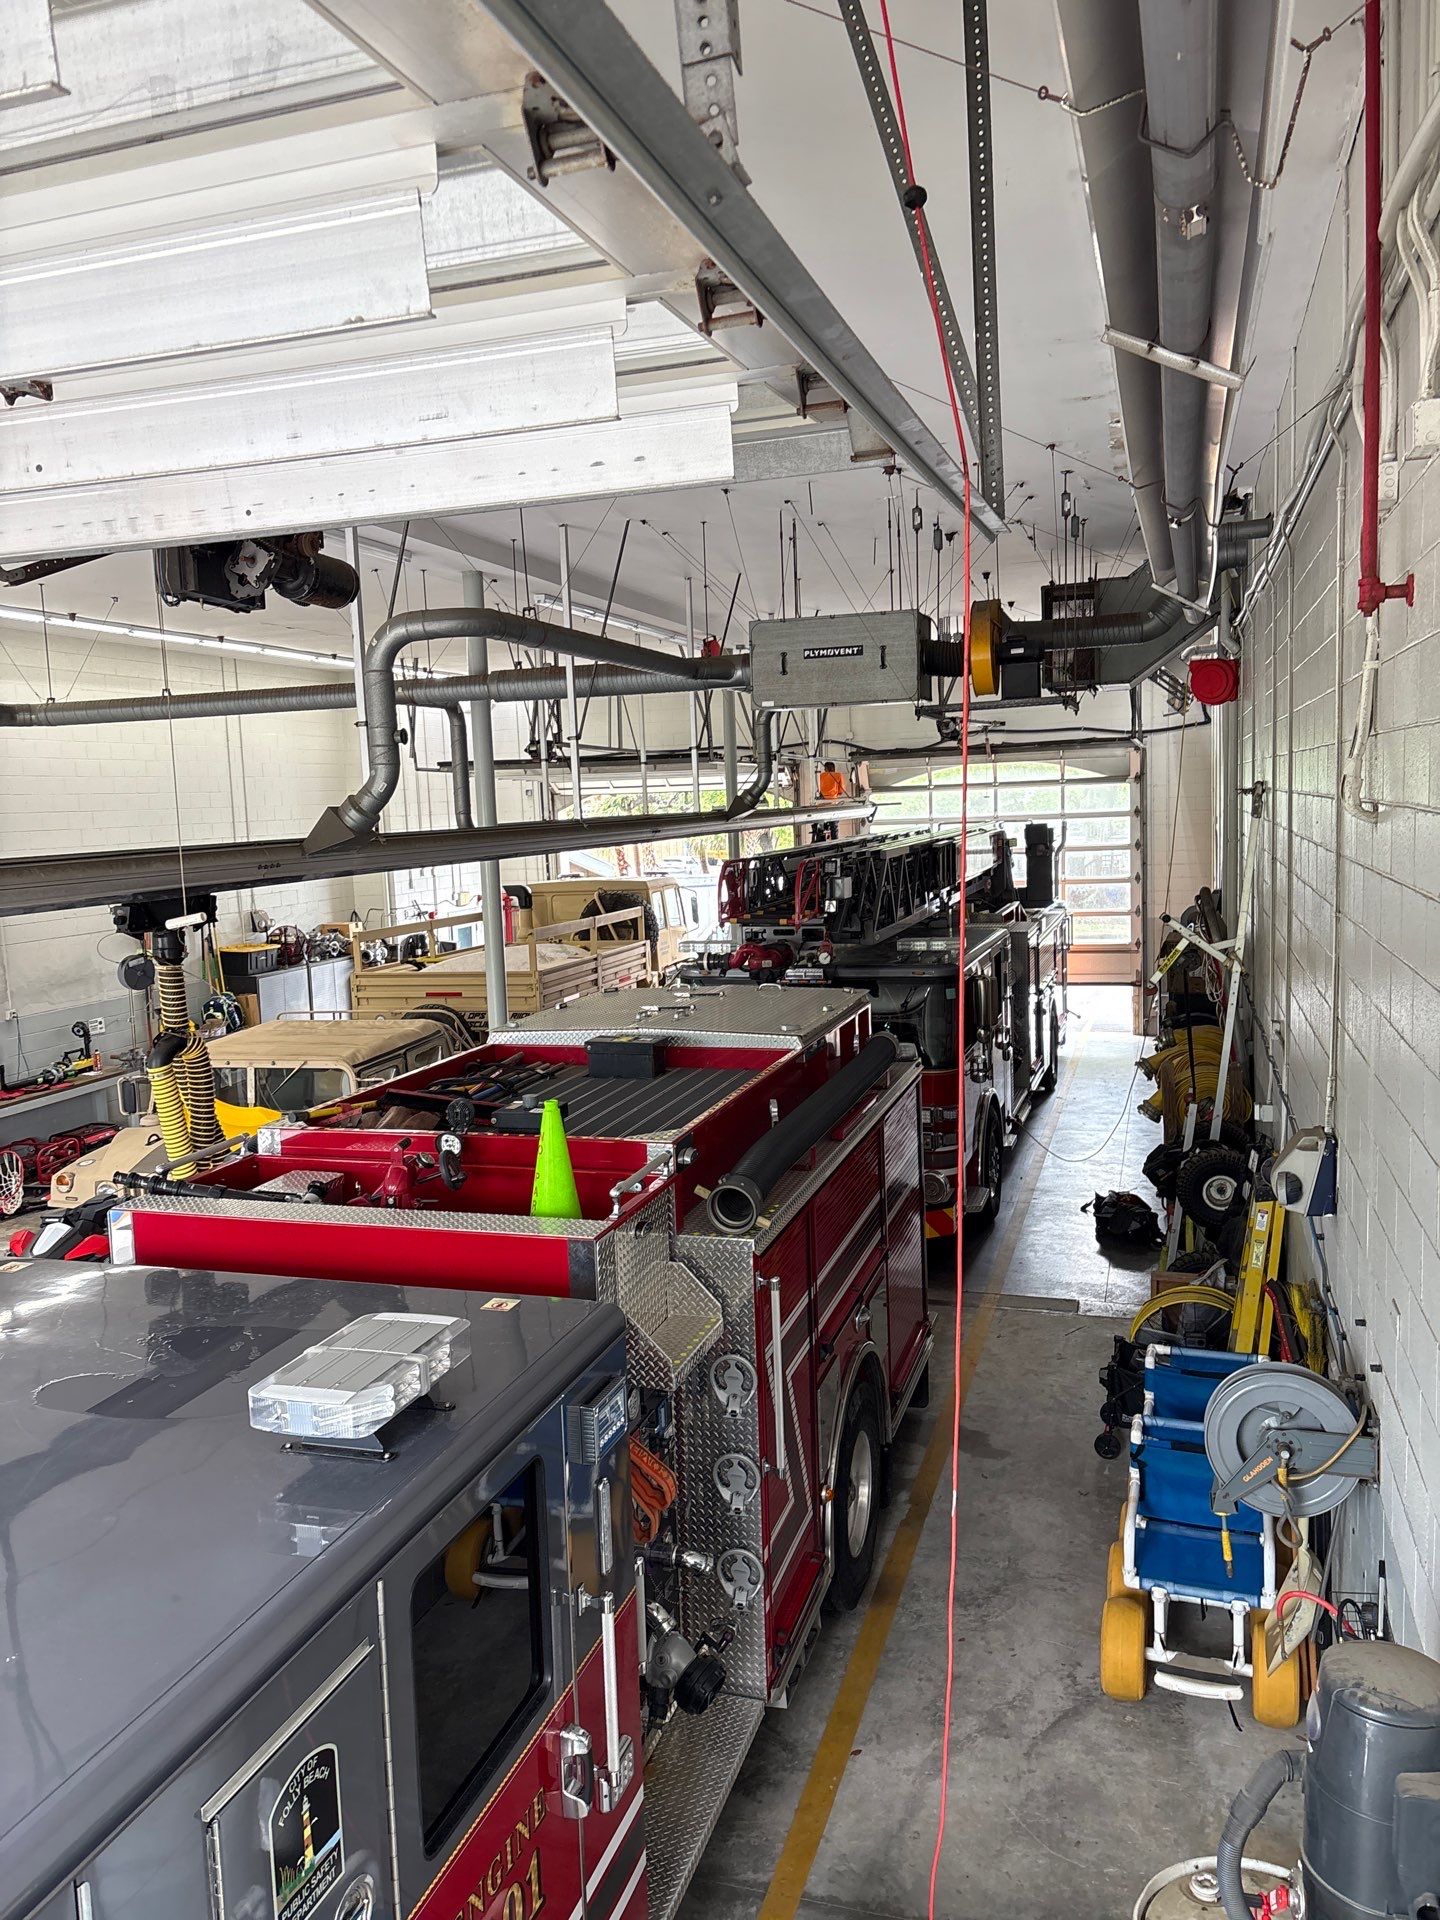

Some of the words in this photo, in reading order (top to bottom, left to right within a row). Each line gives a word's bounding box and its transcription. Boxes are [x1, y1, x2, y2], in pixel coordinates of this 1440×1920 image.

[804, 646, 859, 657] PLYMOVENT
[278, 1782, 301, 1827] FOLLY
[303, 1766, 330, 1789] BEACH
[288, 1764, 306, 1793] CITY
[307, 1755, 318, 1771] OF
[281, 1884, 310, 1920] PUBLIC
[311, 1847, 338, 1888] SAFETY
